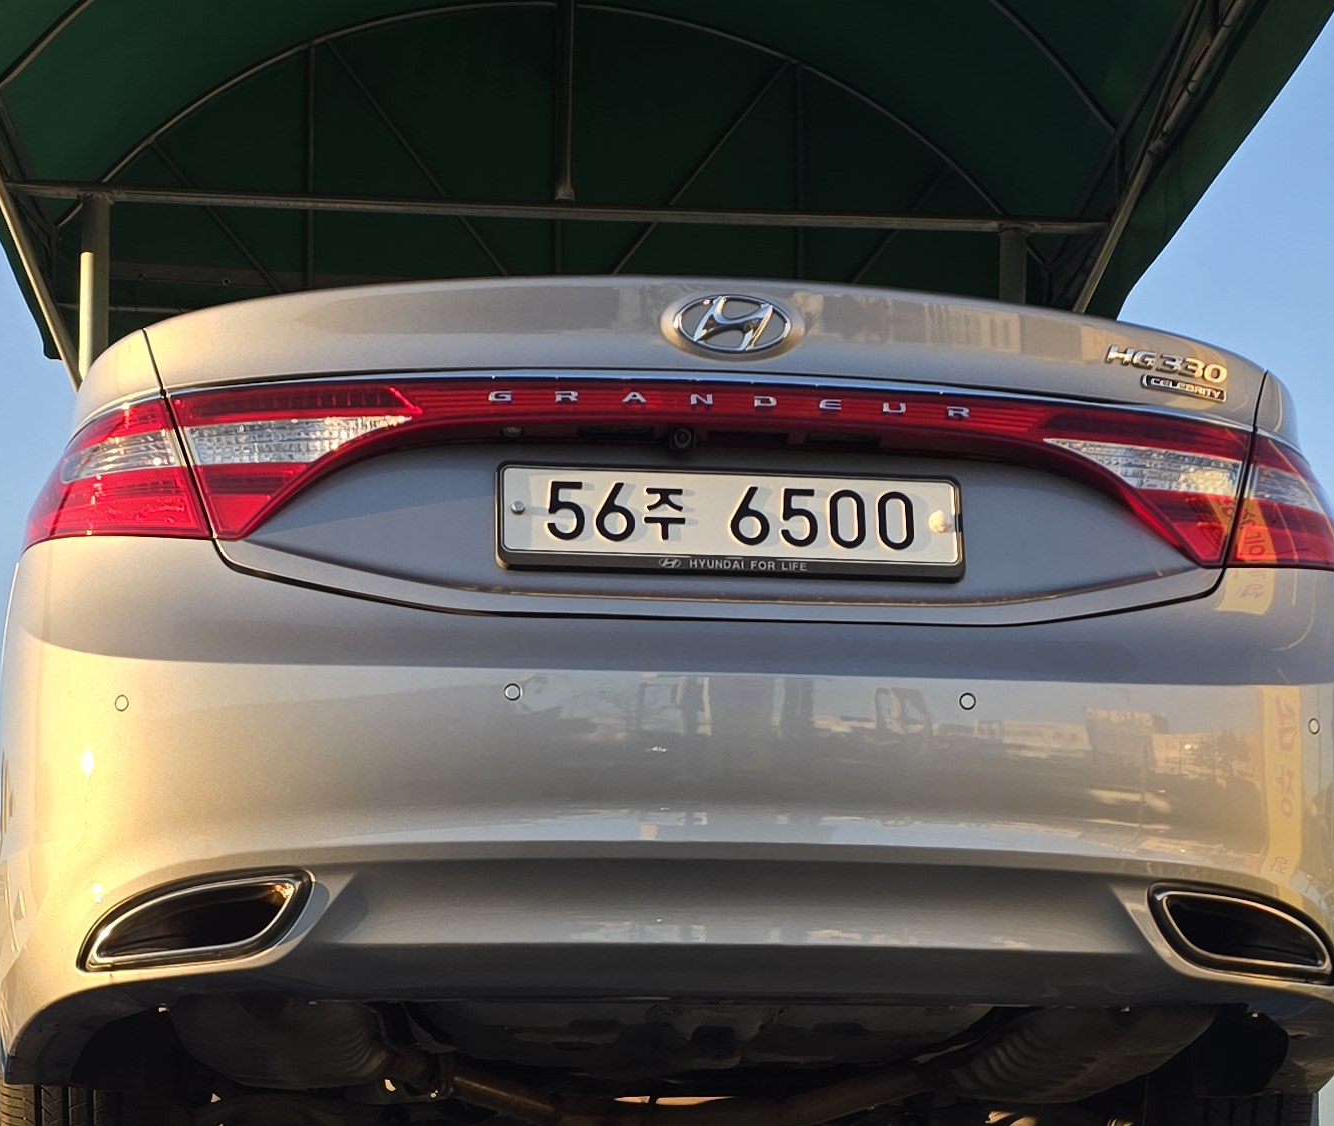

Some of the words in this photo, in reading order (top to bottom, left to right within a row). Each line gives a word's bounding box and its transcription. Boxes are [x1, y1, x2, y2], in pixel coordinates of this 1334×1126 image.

[1150, 377, 1222, 400] CELEBRITY
[487, 389, 971, 420] GRANDEUR
[546, 480, 686, 542] 56주
[729, 485, 915, 551] 6500
[689, 558, 745, 570] HYUNDAI
[750, 560, 776, 570] FOR
[781, 561, 808, 572] LIFE
